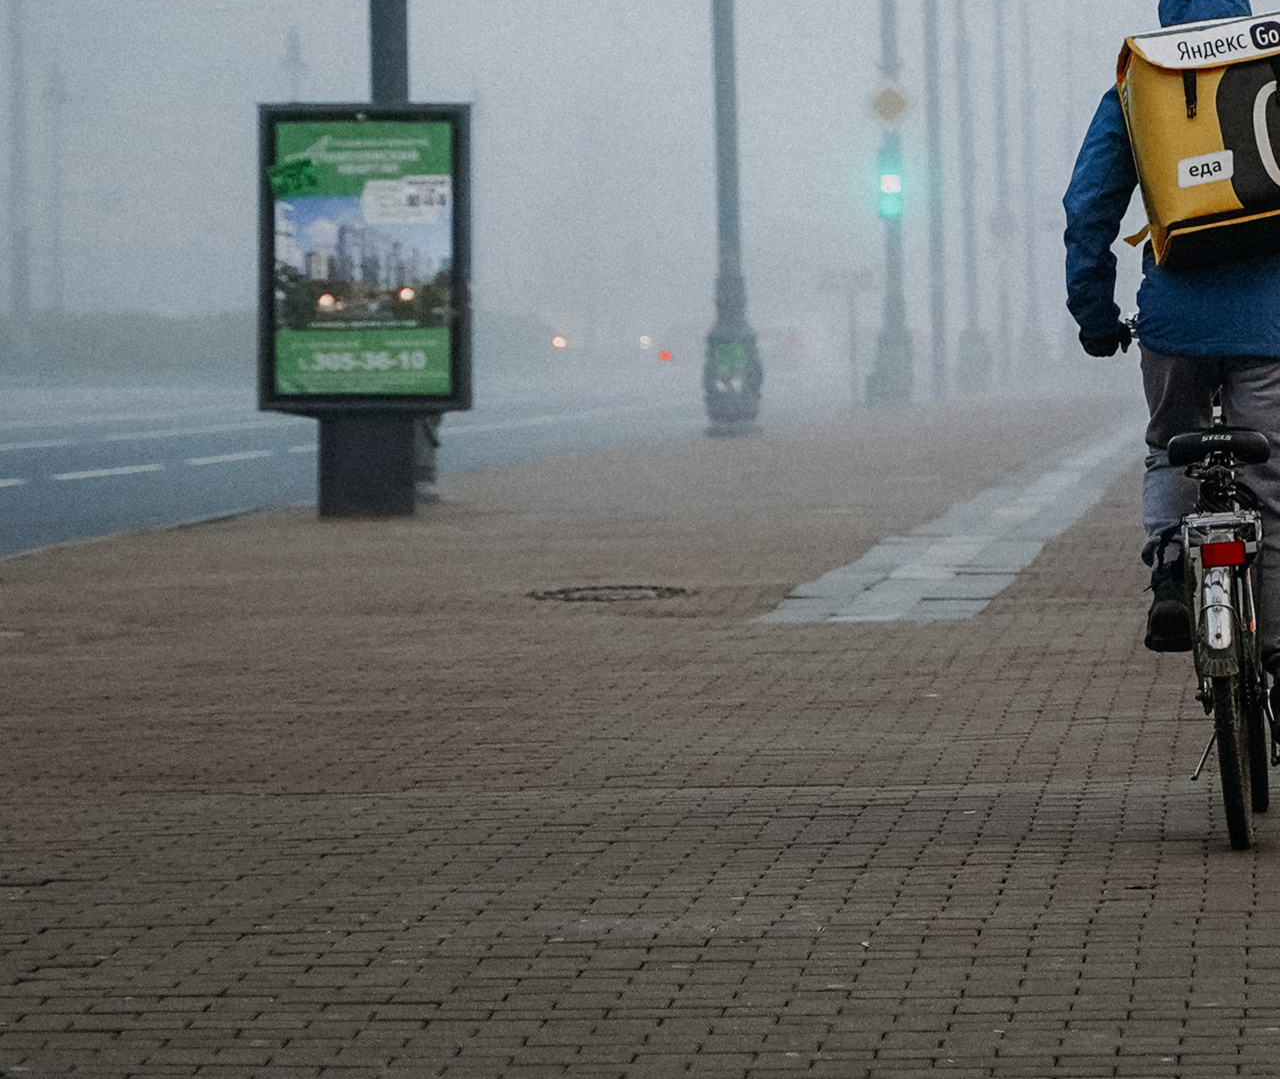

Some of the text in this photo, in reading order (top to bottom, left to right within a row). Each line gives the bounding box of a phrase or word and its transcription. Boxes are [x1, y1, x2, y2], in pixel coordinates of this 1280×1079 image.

[1177, 27, 1280, 60] Яндекс Go
[1189, 161, 1222, 177] еда
